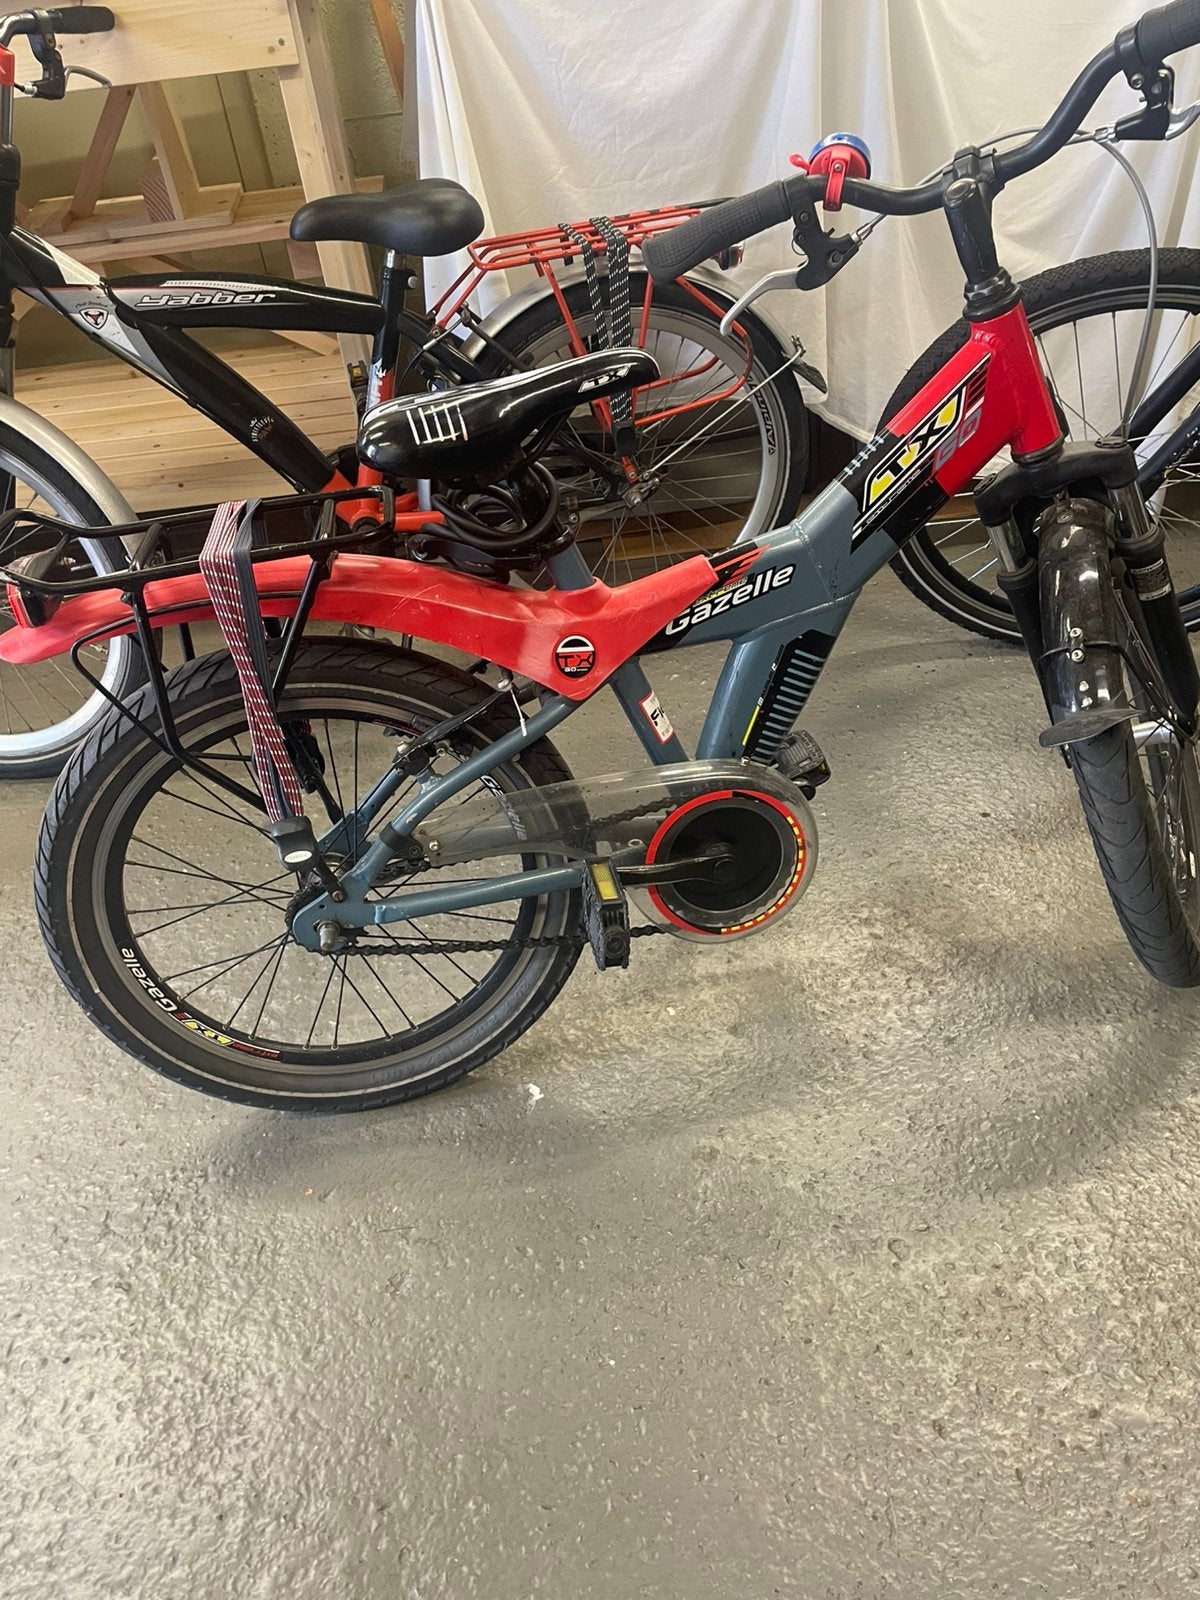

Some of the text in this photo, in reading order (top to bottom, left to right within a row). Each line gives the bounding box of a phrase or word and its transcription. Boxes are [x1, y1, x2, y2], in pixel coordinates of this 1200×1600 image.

[874, 408, 952, 486] TX
[664, 566, 795, 636] Gazelle
[558, 652, 594, 668] TX
[121, 947, 178, 1012] Gazelle
